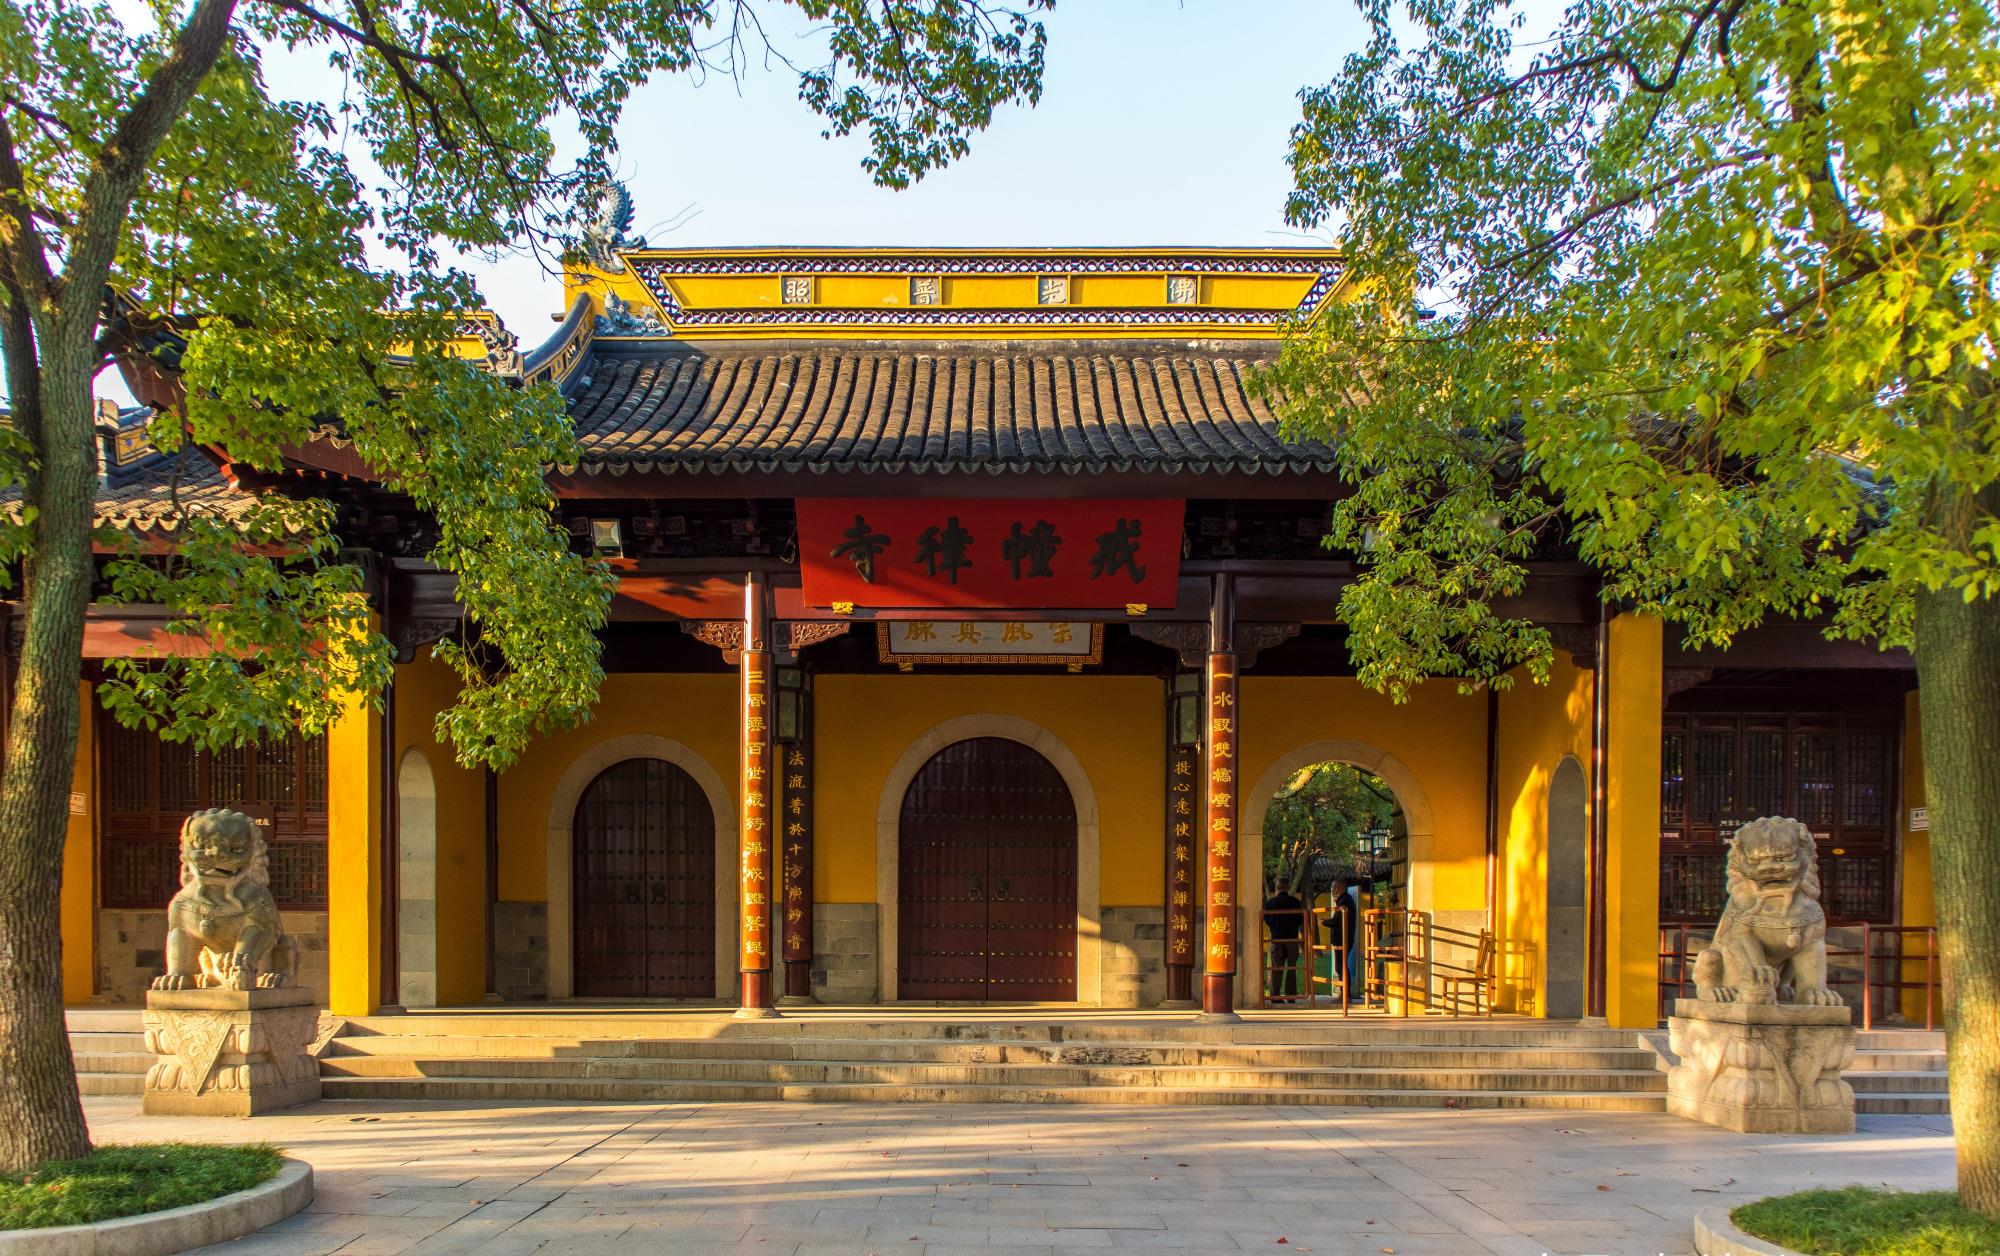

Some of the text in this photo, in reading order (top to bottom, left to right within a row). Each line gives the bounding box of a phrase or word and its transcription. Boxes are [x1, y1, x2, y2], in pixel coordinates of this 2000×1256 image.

[784, 278, 1196, 304] 佛光普照
[830, 513, 1147, 585] 戒幢律寺
